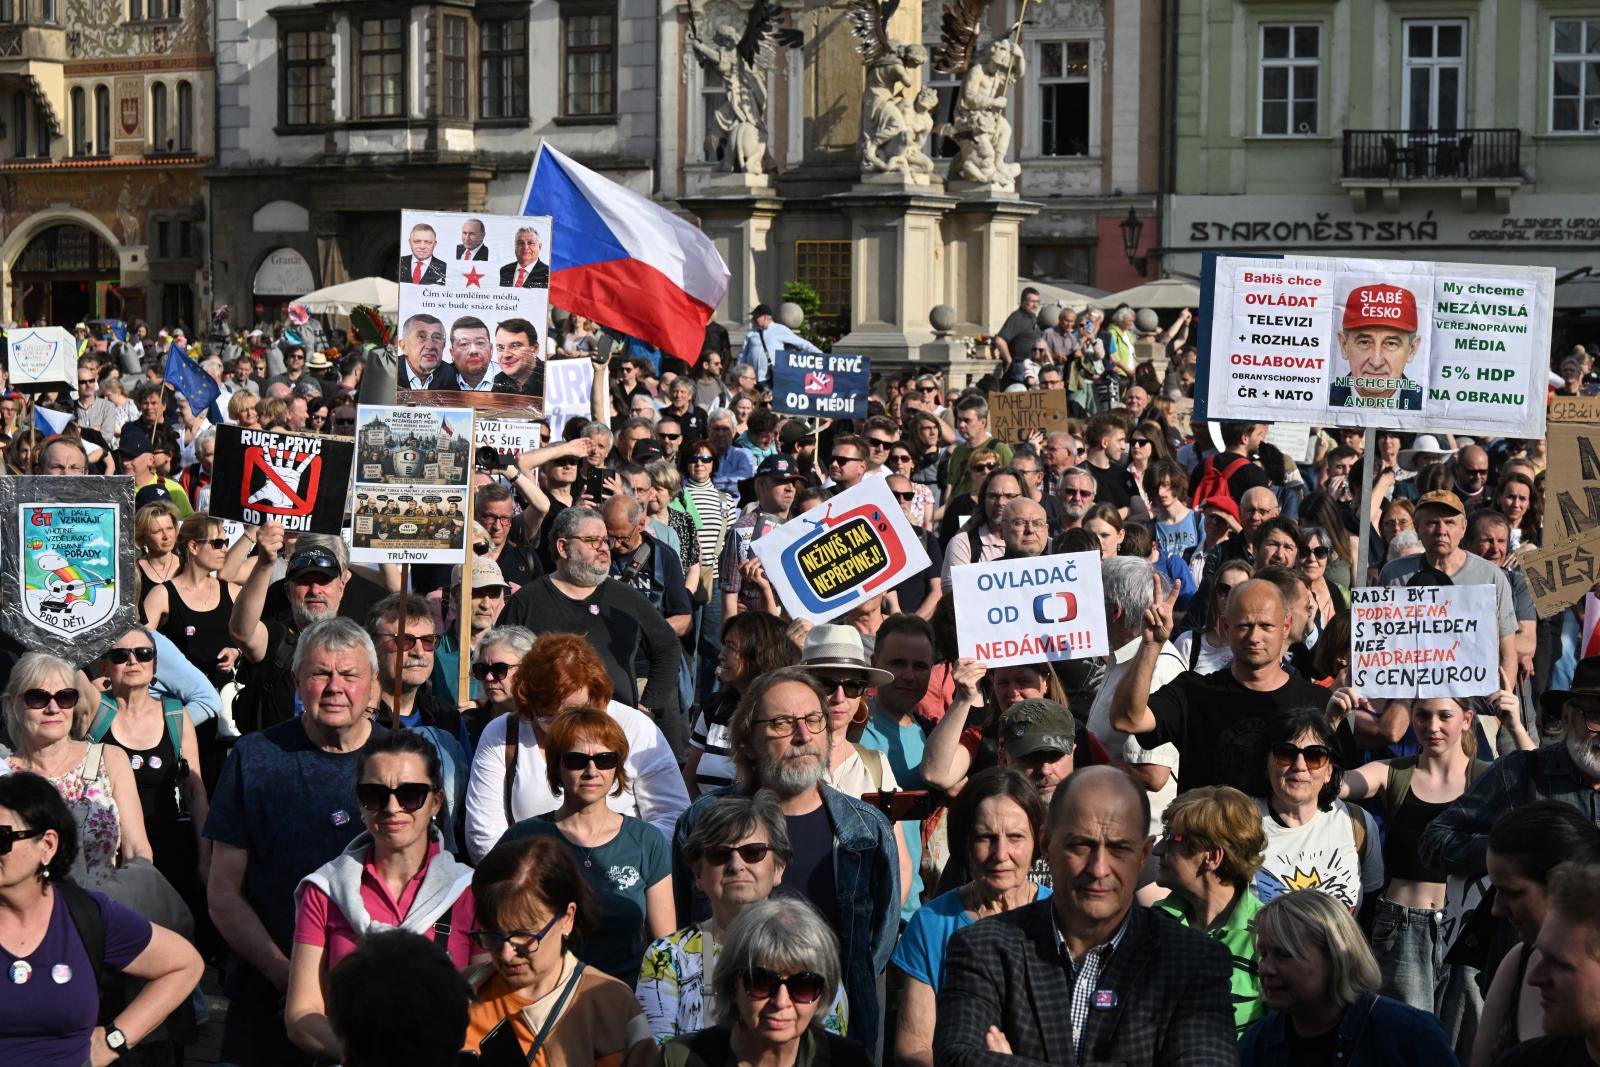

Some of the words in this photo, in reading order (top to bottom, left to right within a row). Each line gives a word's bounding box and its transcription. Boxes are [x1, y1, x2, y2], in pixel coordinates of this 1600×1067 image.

[1190, 210, 1437, 241] STAROMĚSTSKÁ
[1502, 218, 1562, 229] PILSNER
[1468, 230, 1530, 241] ORIGINAL
[1244, 272, 1283, 285] Babiš
[1288, 273, 1322, 287] chce
[422, 288, 440, 298] Čím
[455, 292, 491, 300] umlčíme
[492, 293, 520, 302] média,
[1360, 289, 1403, 305] SLABÉ
[1443, 282, 1464, 295] My
[1468, 284, 1525, 297] chceme
[448, 301, 469, 309] bude
[1245, 292, 1318, 308] OVLÁDAT
[1361, 303, 1402, 319] ČESKO
[1437, 301, 1528, 317] NEZÁVISLÁ
[1248, 314, 1313, 328] TELEVIZI
[1436, 320, 1527, 334] VEŘEJNOPRÁVNÍ
[1239, 334, 1247, 343] +
[1252, 334, 1320, 348] ROZHLAS
[1455, 337, 1506, 351] MÉDIA
[788, 354, 824, 370] RUCE
[828, 355, 862, 373] PRYČ
[1231, 354, 1325, 370] OSLABOVAT
[1232, 372, 1322, 384] OBRANYSCHOPNOST
[1476, 368, 1515, 382] HDP
[1335, 376, 1420, 393] NECHCEME,
[994, 392, 1047, 410] TAHEJTE
[1237, 385, 1258, 399] ČR
[1262, 390, 1270, 399] +
[1274, 389, 1313, 401] NATO
[1429, 389, 1451, 401] NA
[1456, 390, 1525, 405] OBRANU
[786, 392, 810, 410] OD
[816, 392, 857, 413] MÉDIÍ
[414, 412, 432, 420] PRYČ
[995, 415, 1009, 428] ZA
[1011, 410, 1042, 428] NITKY
[240, 429, 280, 450] RUCE
[501, 432, 521, 445] ŠIJE
[31, 507, 52, 526] ČT
[60, 512, 105, 524] VZNIKAJÍ
[243, 508, 261, 525] OD
[64, 547, 101, 558] POŘADY
[388, 552, 428, 560] TRUTNOV
[801, 532, 853, 573] NEŽIVÍŠ,
[844, 523, 872, 549] TAK
[812, 544, 884, 595] NEPŘEPÍNEJ!
[977, 559, 1078, 592] OVLADAČ
[1351, 586, 1395, 604] RADŠI
[1407, 586, 1440, 604] BÝT
[40, 612, 58, 626] PRO
[63, 616, 86, 628] DĚTI
[987, 606, 1019, 625] OD
[1355, 622, 1365, 638] S
[1372, 618, 1478, 636] ROZHLEDEM
[975, 630, 1092, 661] NEDÁME!!!
[1354, 636, 1387, 652] NEŽ
[1354, 669, 1367, 687] S
[1375, 665, 1487, 687] CENZUROU
